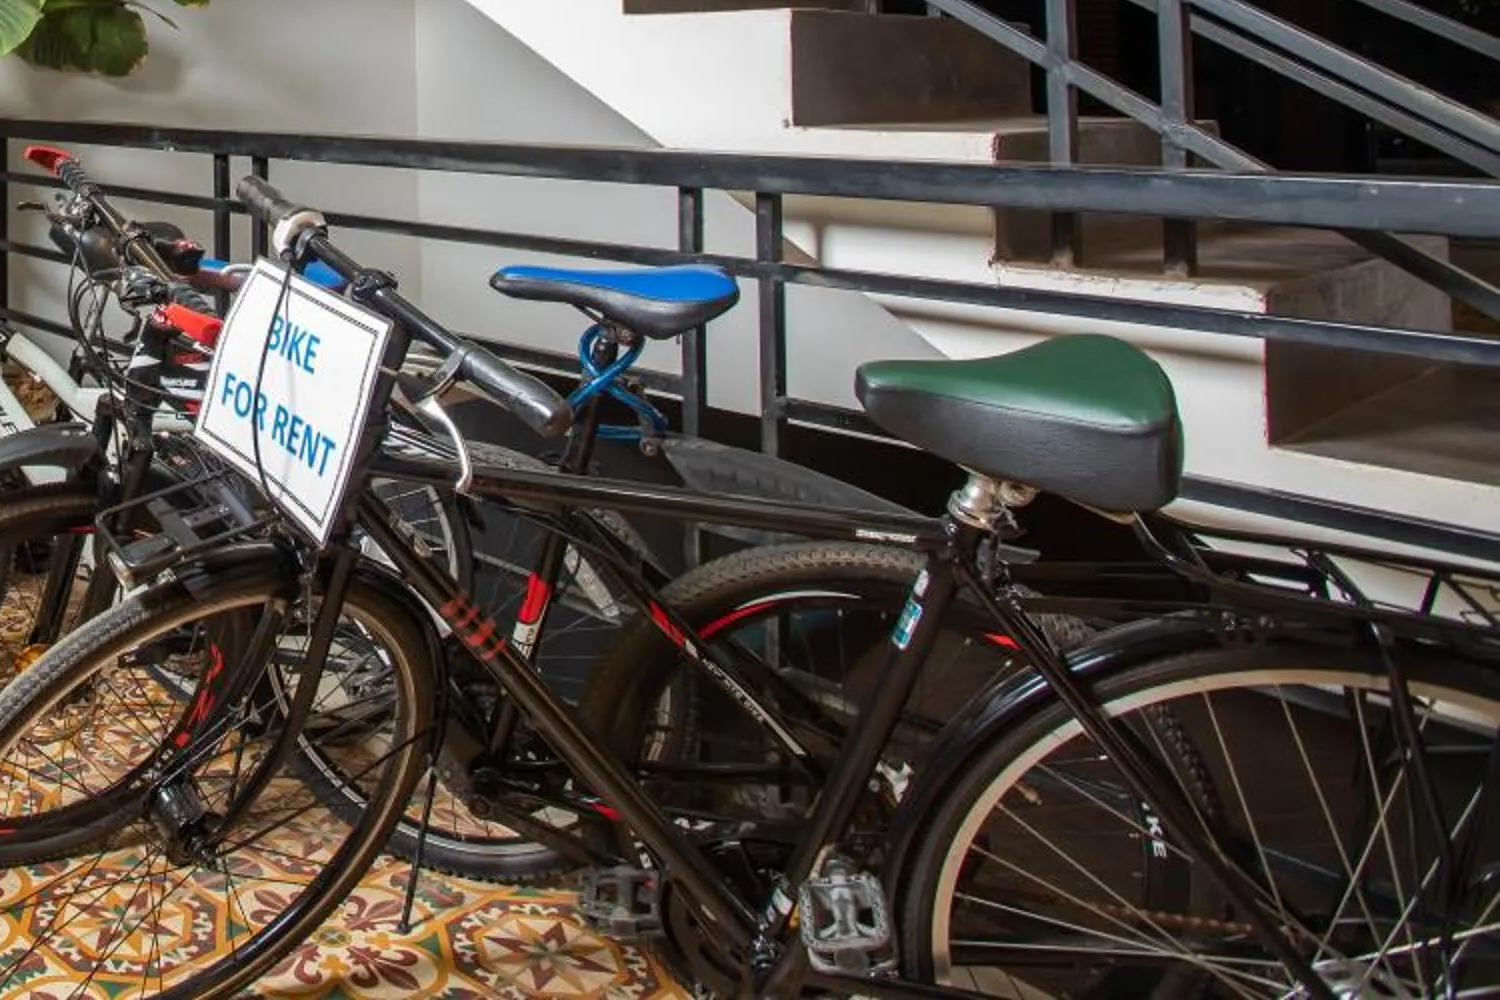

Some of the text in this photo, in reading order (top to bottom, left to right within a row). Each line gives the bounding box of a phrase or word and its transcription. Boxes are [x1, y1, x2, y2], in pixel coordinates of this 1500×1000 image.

[266, 315, 321, 375] BIKE
[220, 372, 336, 477] FOR RENT
